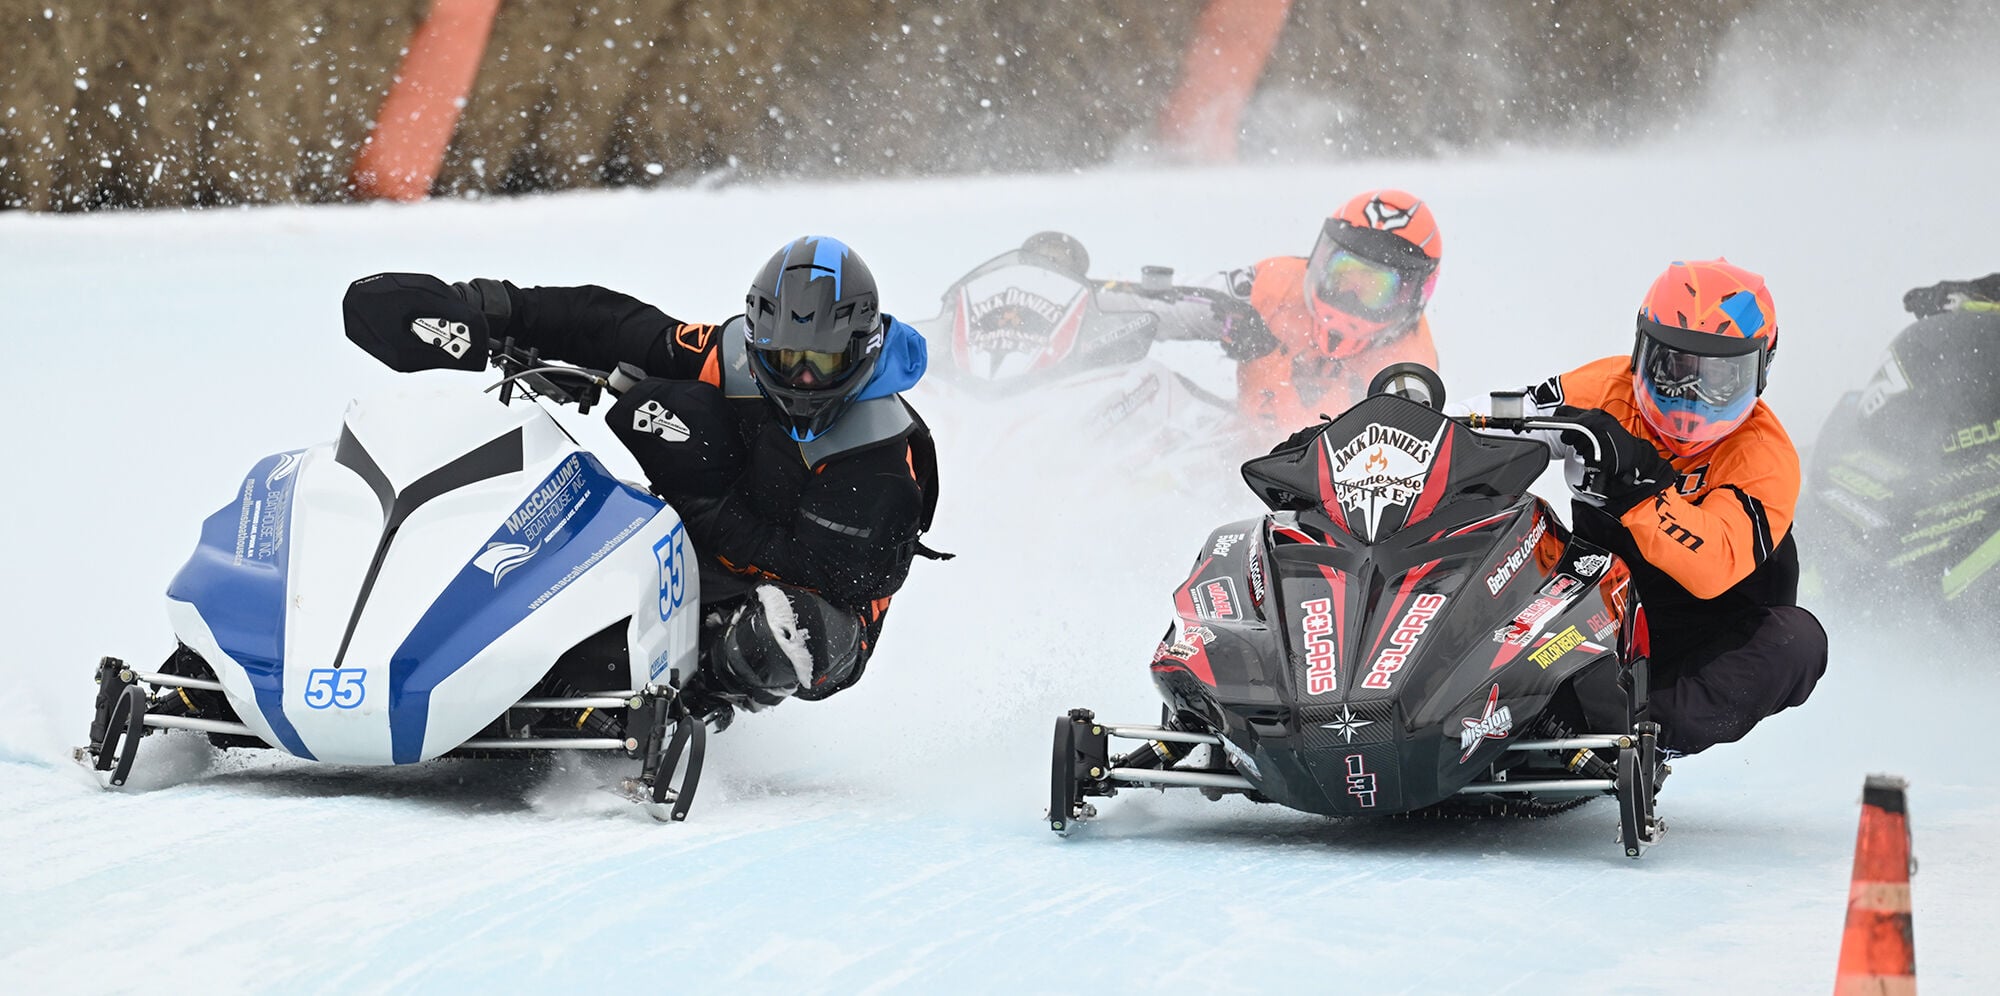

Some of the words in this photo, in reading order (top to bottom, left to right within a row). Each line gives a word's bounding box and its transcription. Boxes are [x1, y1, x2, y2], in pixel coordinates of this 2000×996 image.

[1335, 436, 1367, 473] JACK
[1368, 425, 1431, 464] DANIEL'S
[1337, 474, 1422, 500] Tennessee
[1349, 486, 1405, 509] FIRE
[260, 490, 280, 541] BOATHOUSE,
[525, 490, 574, 542] BOATHOUSE,
[1520, 515, 1547, 559] LOGGING
[528, 516, 646, 611] www.maccallumsboathouse.com
[652, 520, 685, 622] 55
[1249, 554, 1265, 602] LOGGING
[1207, 581, 1233, 619] WAHL
[1586, 610, 1612, 633] DELL
[1302, 598, 1336, 694] POLARIS
[1362, 593, 1447, 689] POLARIS
[1531, 640, 1565, 669] TAYLOR
[1559, 629, 1587, 660] RENTAL
[304, 668, 367, 709] 55
[1460, 706, 1512, 750] Mission
[1345, 754, 1377, 807] 131
